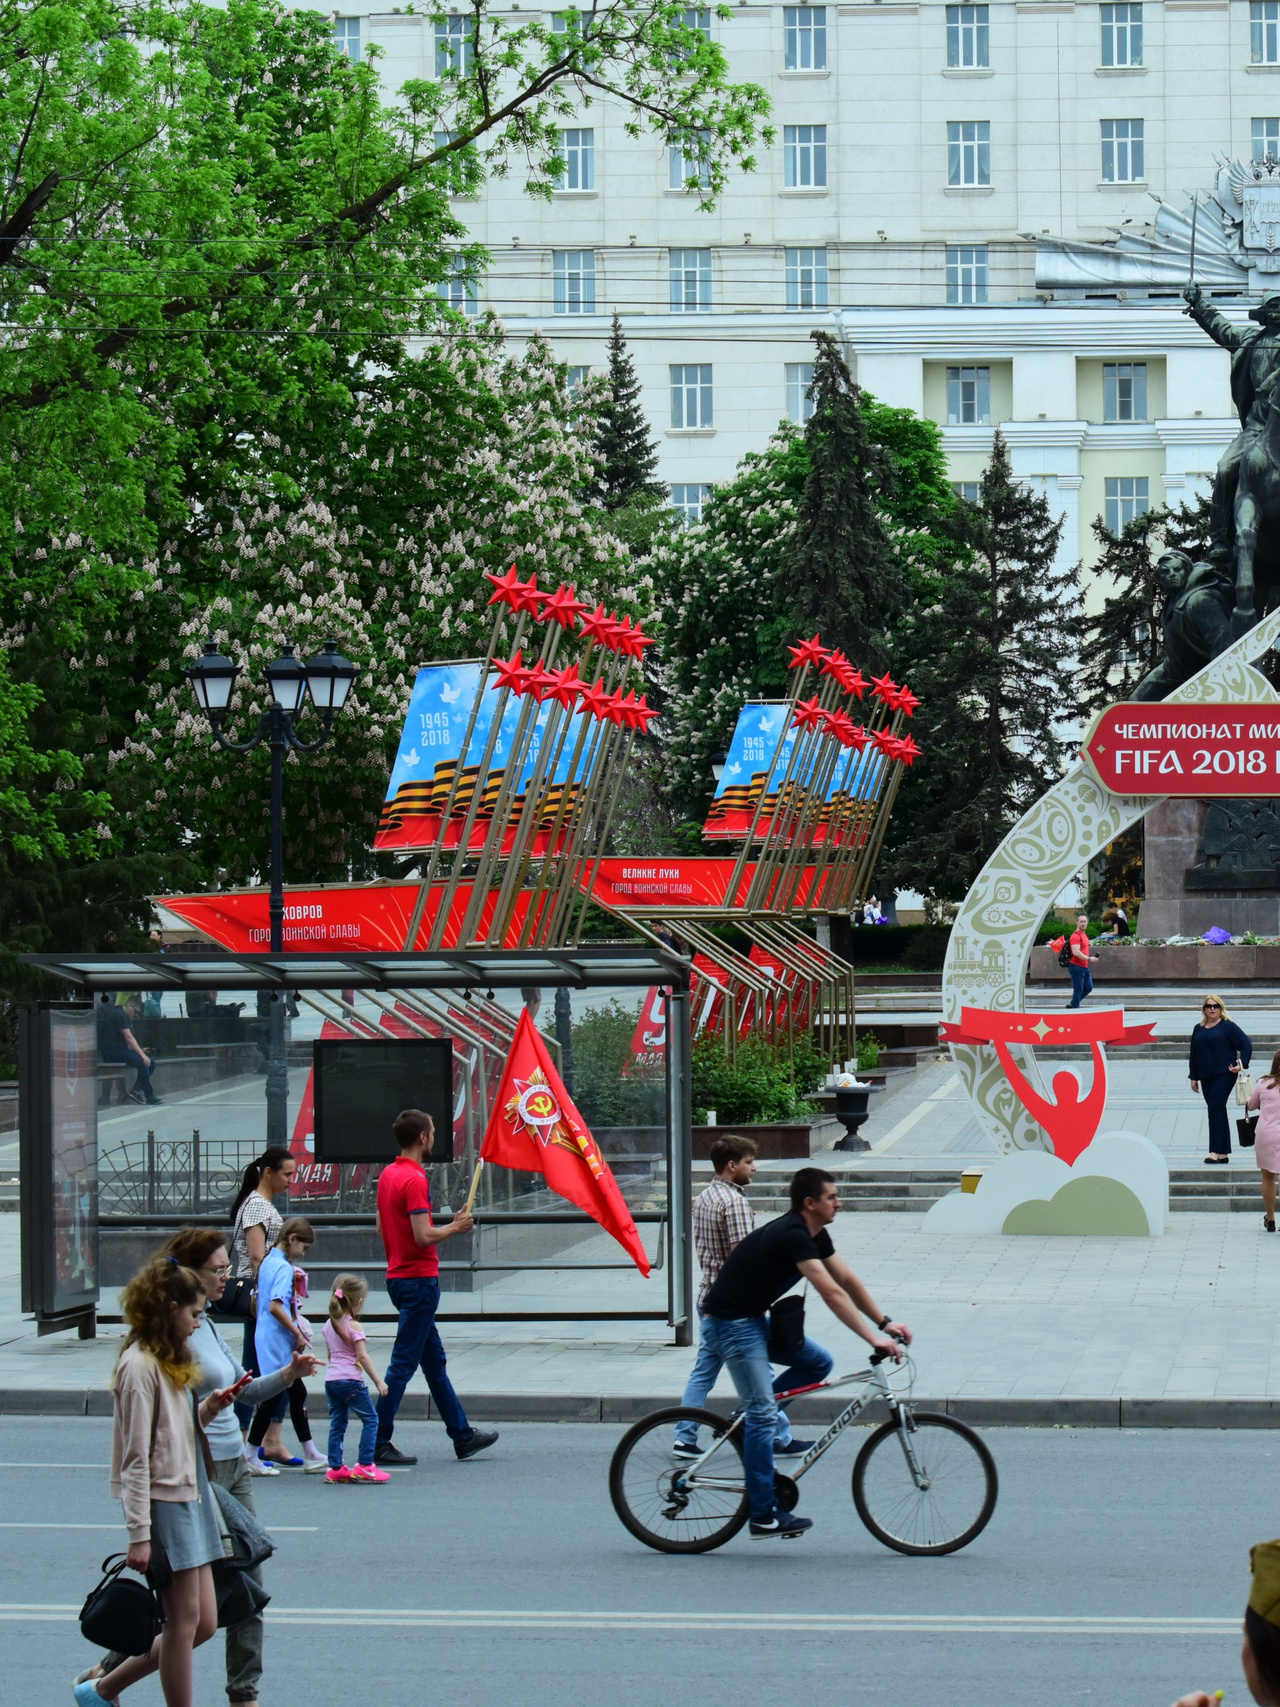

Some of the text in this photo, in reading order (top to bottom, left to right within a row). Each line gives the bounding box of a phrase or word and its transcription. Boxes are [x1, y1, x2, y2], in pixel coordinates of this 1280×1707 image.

[420, 713, 449, 728] 1945
[421, 729, 450, 746] 2018
[1114, 723, 1244, 739] ЧЕМПИОНАТ
[743, 737, 764, 748] 1945
[743, 749, 764, 761] 2018
[1115, 750, 1184, 774] FIFA
[1192, 750, 1267, 774] 2018
[622, 868, 680, 879] ВЕЛИКИЕ ЛУКИ
[611, 882, 693, 894] ГОРОД ВОИНСКОЙ СЛАВЫ
[282, 905, 323, 920] КОВРОВ
[249, 928, 272, 943] ГОРО
[329, 924, 360, 939] СЛАВЫ
[804, 1399, 862, 1464] MERIDA
